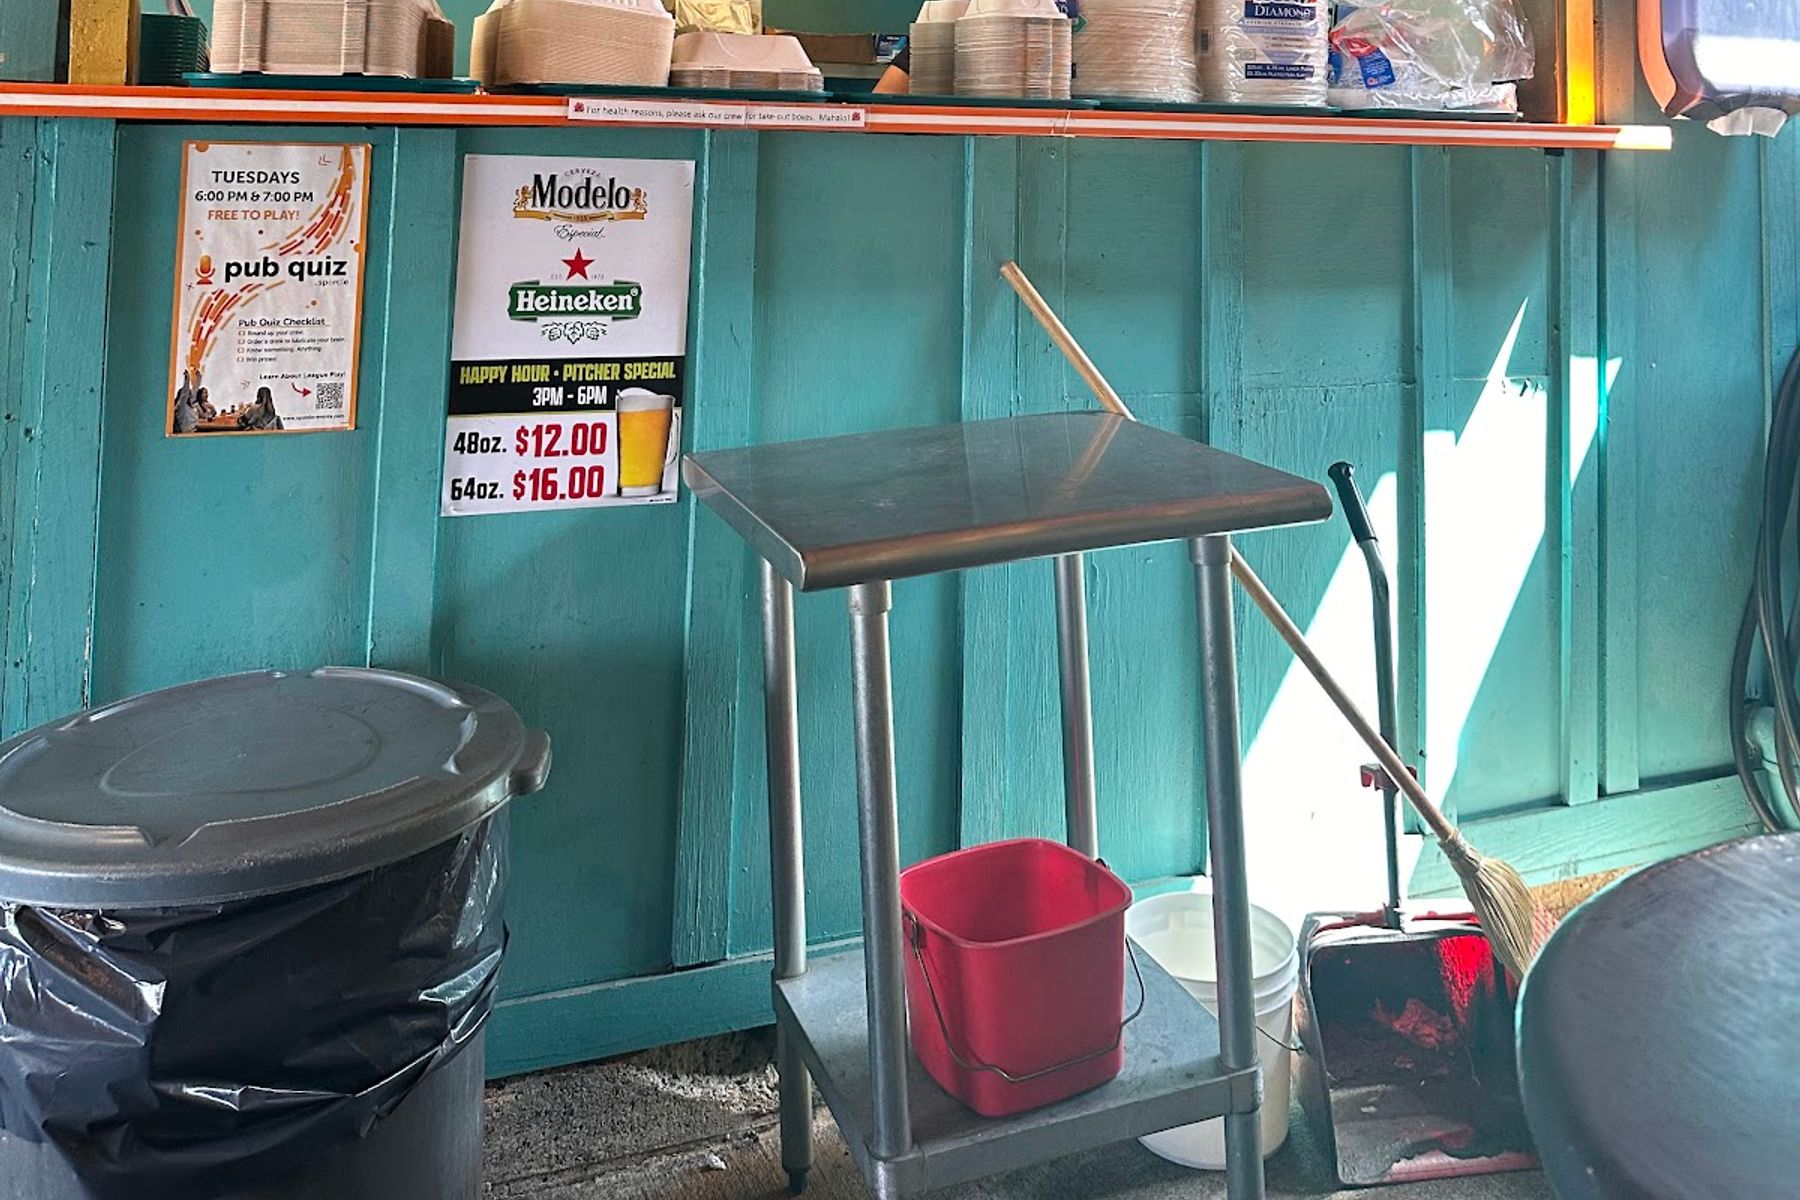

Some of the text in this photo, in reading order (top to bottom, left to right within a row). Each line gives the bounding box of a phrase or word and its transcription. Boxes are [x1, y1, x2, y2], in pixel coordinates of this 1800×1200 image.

[603, 106, 629, 116] health
[666, 109, 692, 120] please
[694, 110, 706, 119] ask
[212, 170, 301, 185] TUESDAYS
[195, 191, 314, 203] 6:00 PM & 7:00 PM
[531, 174, 631, 210] Modelo
[208, 210, 300, 221] FREE TO PLAY!
[554, 224, 606, 242] Especial
[225, 255, 348, 284] pub quiz
[516, 289, 634, 313] Heineken
[238, 318, 258, 327] Pub
[280, 371, 328, 380] About League
[460, 361, 676, 384] HAPPY HOUR PITCHER SPECIAL
[532, 386, 608, 407] 3PM 6PM
[453, 422, 608, 458] 48oz. $12.00
[450, 465, 605, 501] 64oz. $16.00
